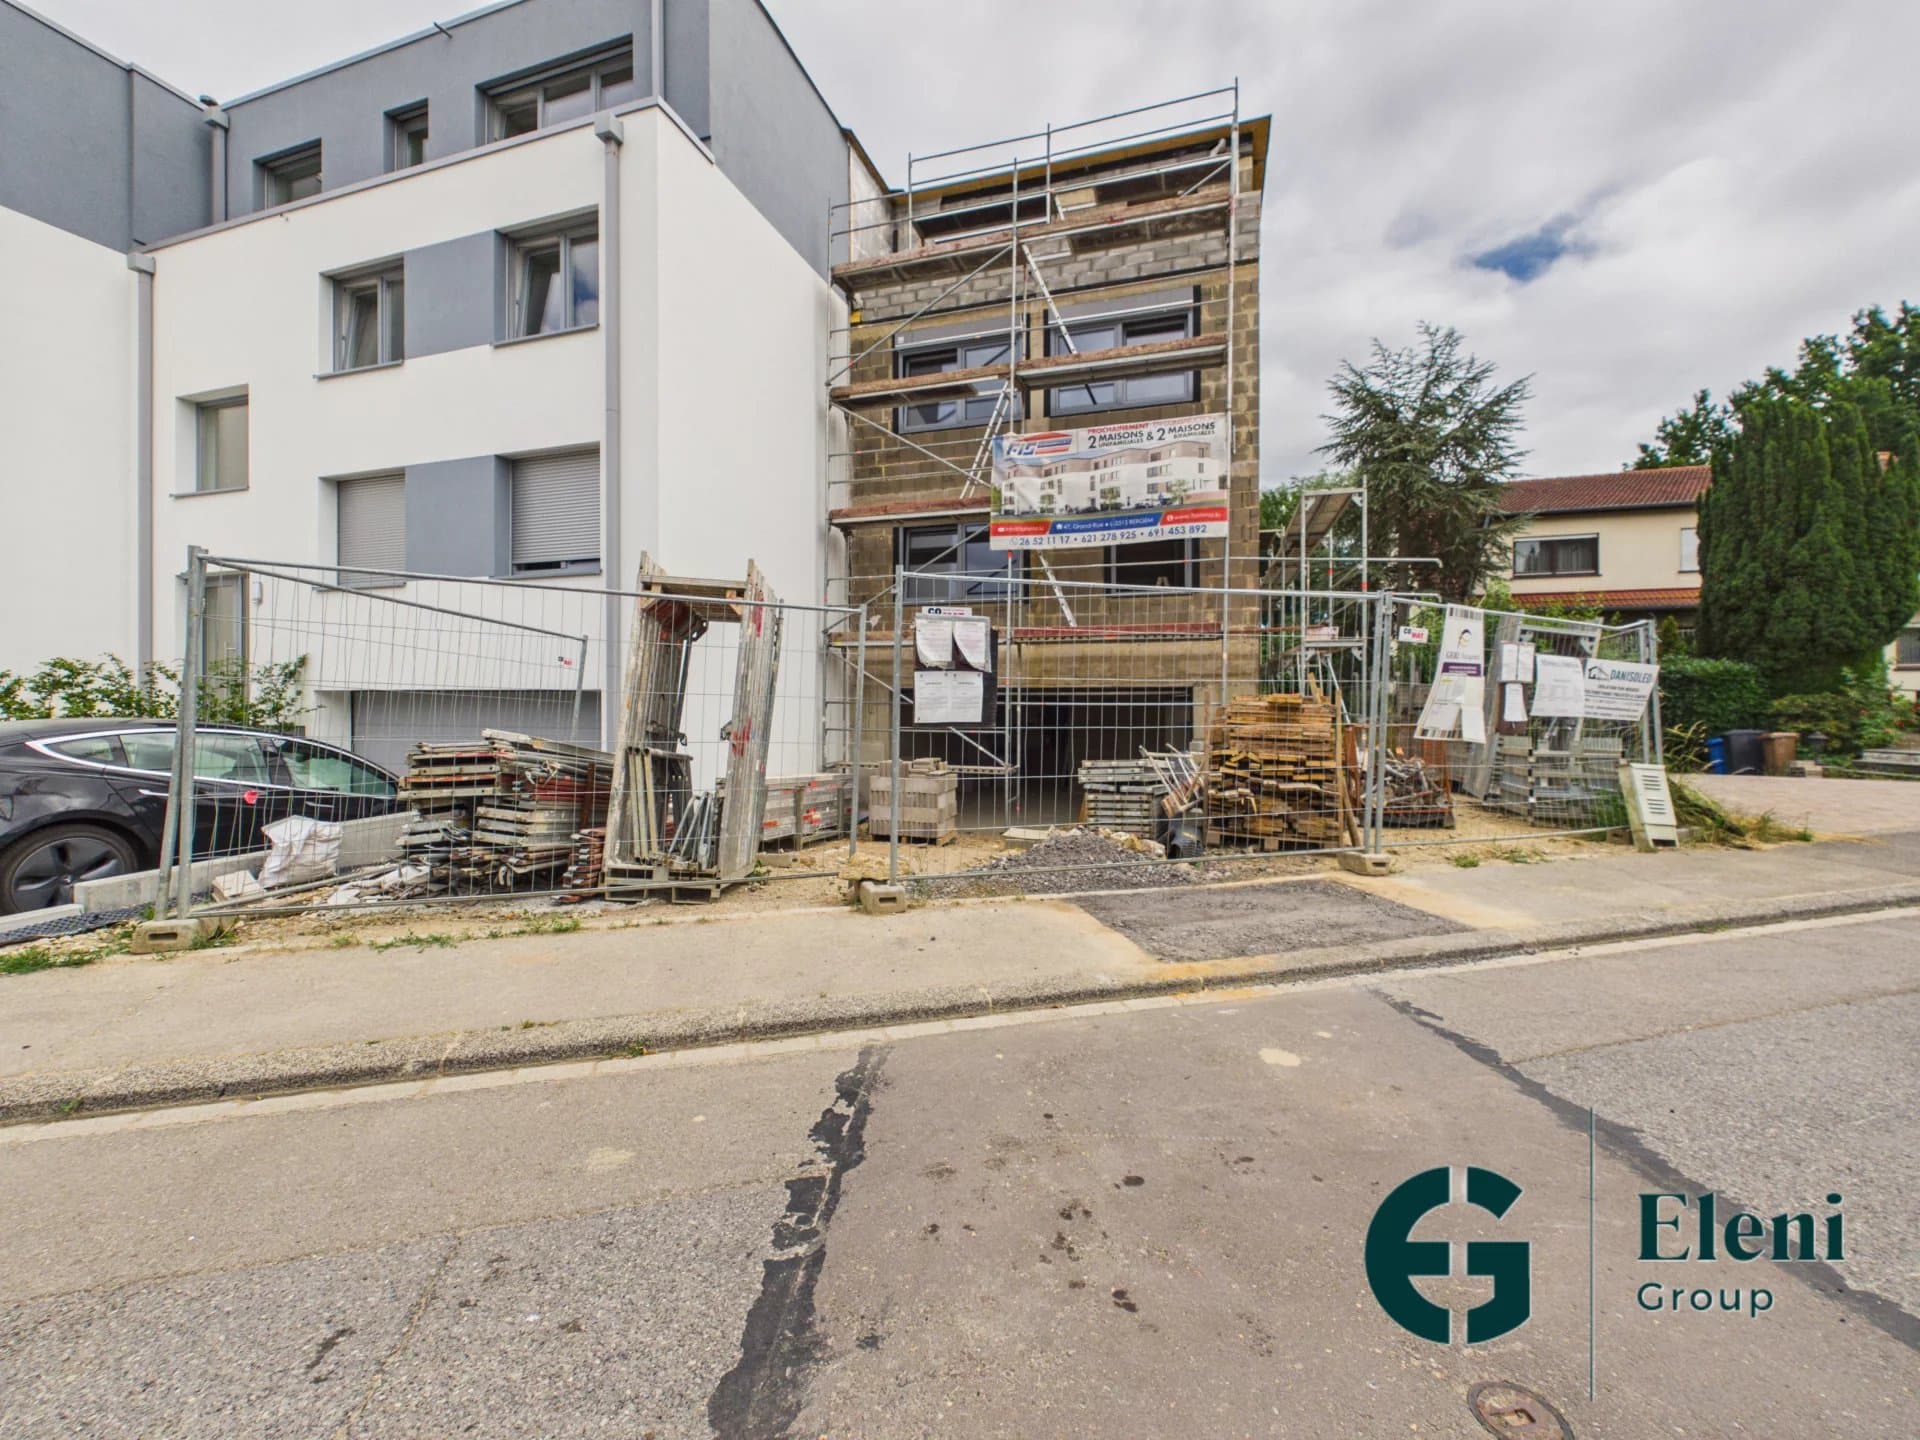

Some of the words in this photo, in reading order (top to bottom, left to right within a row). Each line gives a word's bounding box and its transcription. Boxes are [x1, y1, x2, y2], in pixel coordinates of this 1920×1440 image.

[1088, 435, 1097, 449] 2
[1099, 430, 1144, 442] MAISONS
[1146, 431, 1154, 441] &
[1156, 427, 1166, 441] 2
[1168, 422, 1216, 434] MAISONS
[1019, 537, 1029, 546] 26
[1032, 537, 1044, 545] 52
[1047, 536, 1056, 545] 11
[1060, 535, 1070, 544] 17
[1081, 534, 1097, 543] 621
[1099, 532, 1117, 541] 278
[1119, 530, 1137, 540] 925
[1147, 528, 1165, 537] 691
[1167, 526, 1186, 535] 453
[1188, 524, 1208, 534] 892
